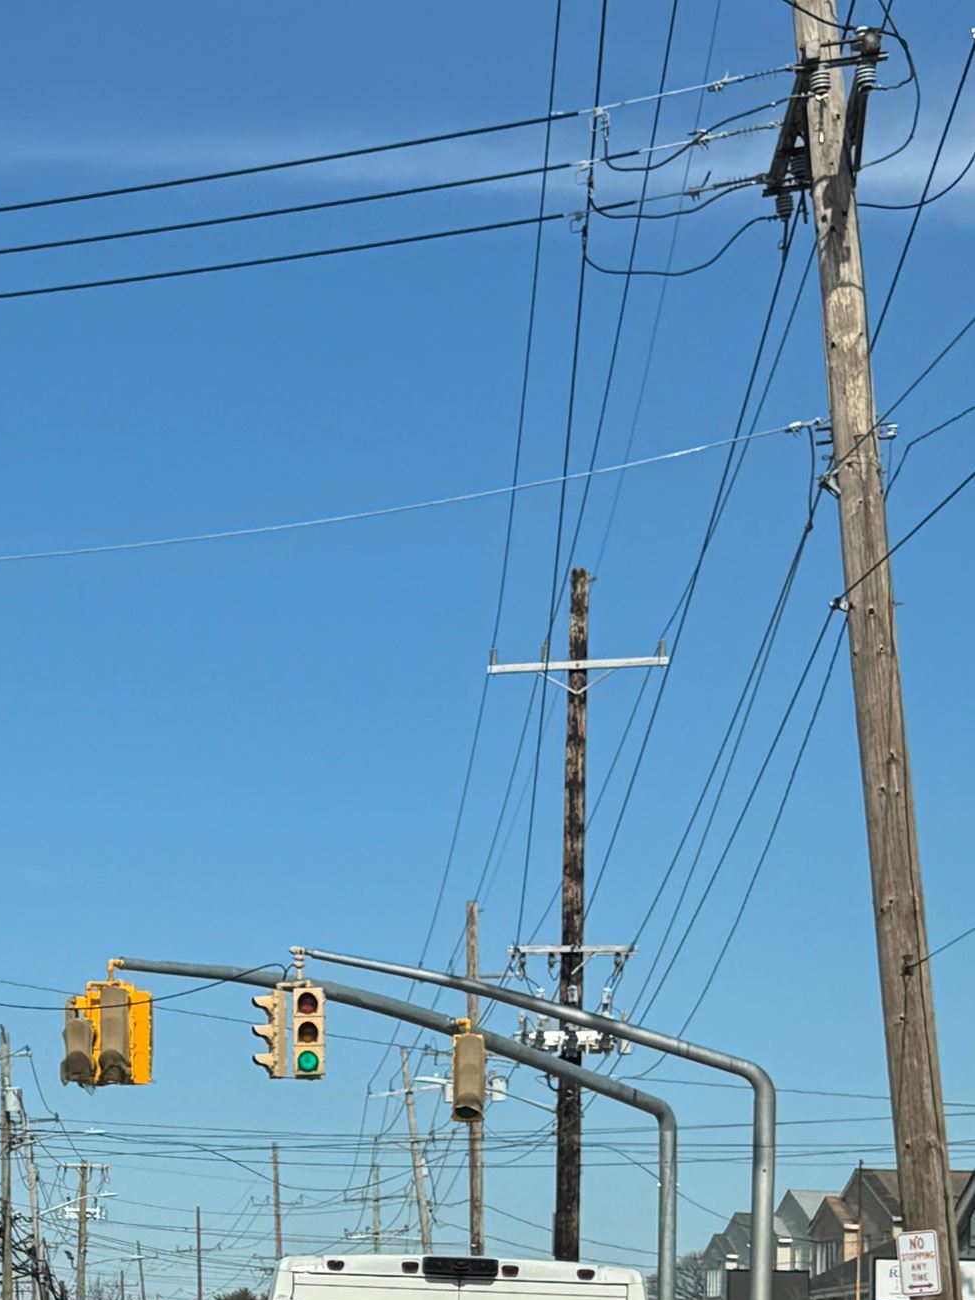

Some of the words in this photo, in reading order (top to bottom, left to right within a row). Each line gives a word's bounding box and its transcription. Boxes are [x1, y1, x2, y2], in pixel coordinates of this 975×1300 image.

[909, 1237, 925, 1250] NO
[900, 1251, 936, 1261] STOPPING
[911, 1263, 927, 1271] ANY
[911, 1272, 930, 1281] TIME
